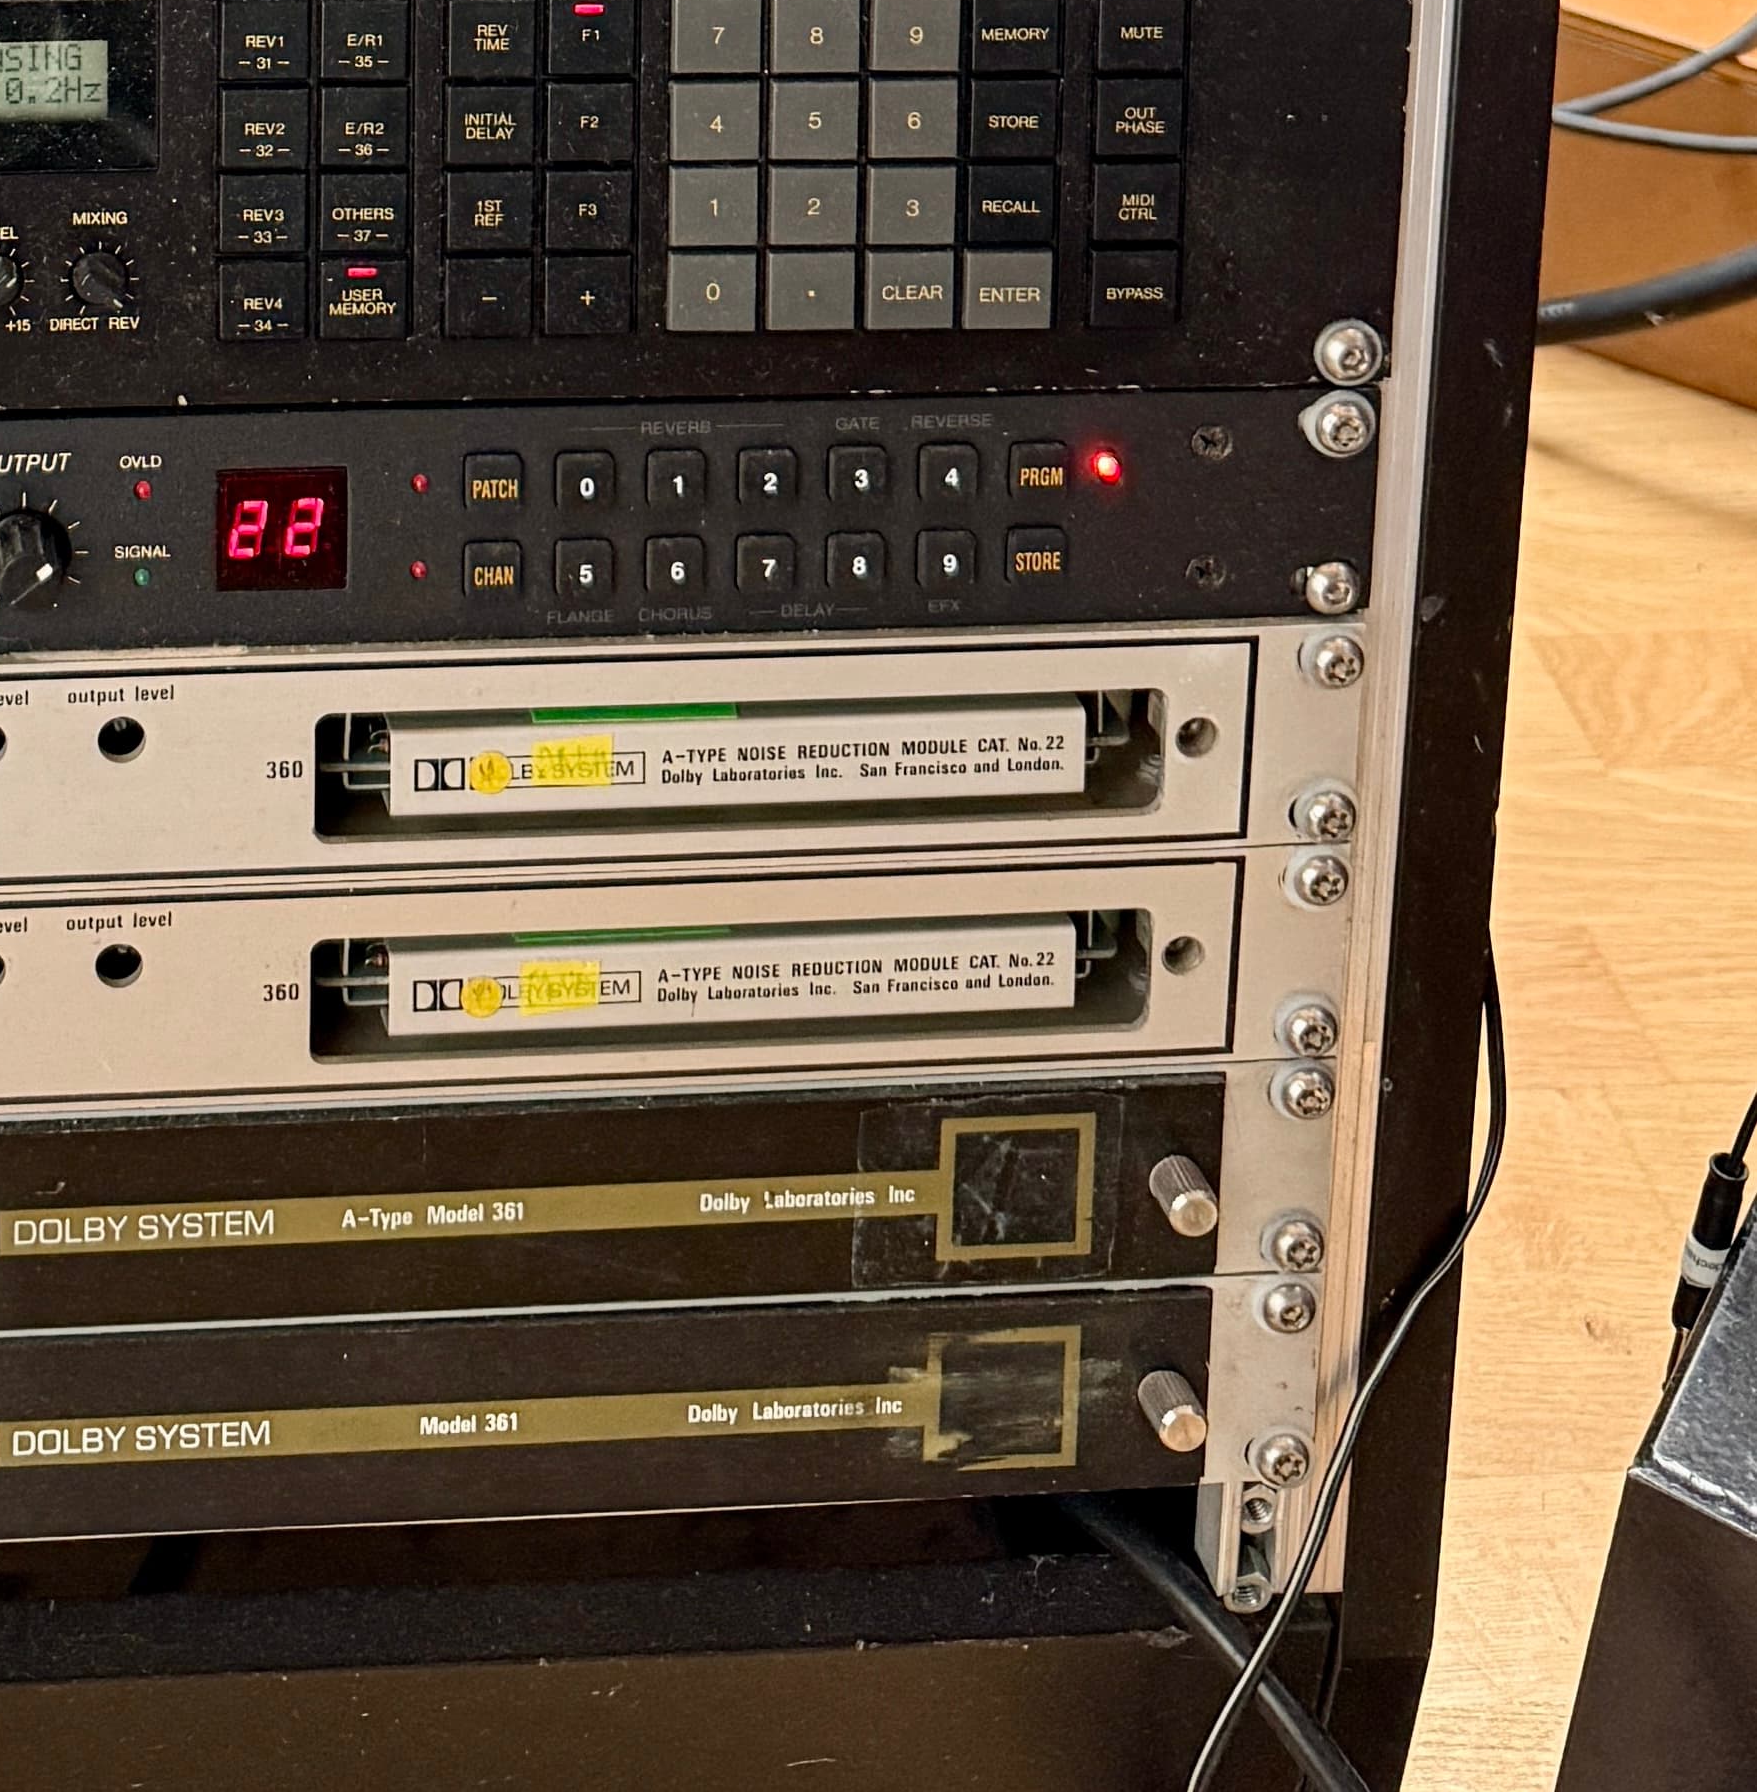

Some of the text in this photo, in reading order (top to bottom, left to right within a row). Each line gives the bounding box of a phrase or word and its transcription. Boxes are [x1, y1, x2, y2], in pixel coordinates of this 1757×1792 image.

[5, 79, 103, 106] 0.2Hz
[332, 208, 394, 221] OTHERS
[472, 479, 519, 501] PATCH
[1015, 551, 1061, 572] STORE
[662, 736, 1065, 763] A-TYPE NOISE REDUCTION MODULE CAT. No. 22
[266, 759, 303, 780] 360
[662, 762, 842, 785] Dolby Laboratories Inc.
[13, 1201, 524, 1246] DOLBY SYSTEM A-Type Model 361
[12, 1421, 271, 1456] DOLBY SYSTEM
